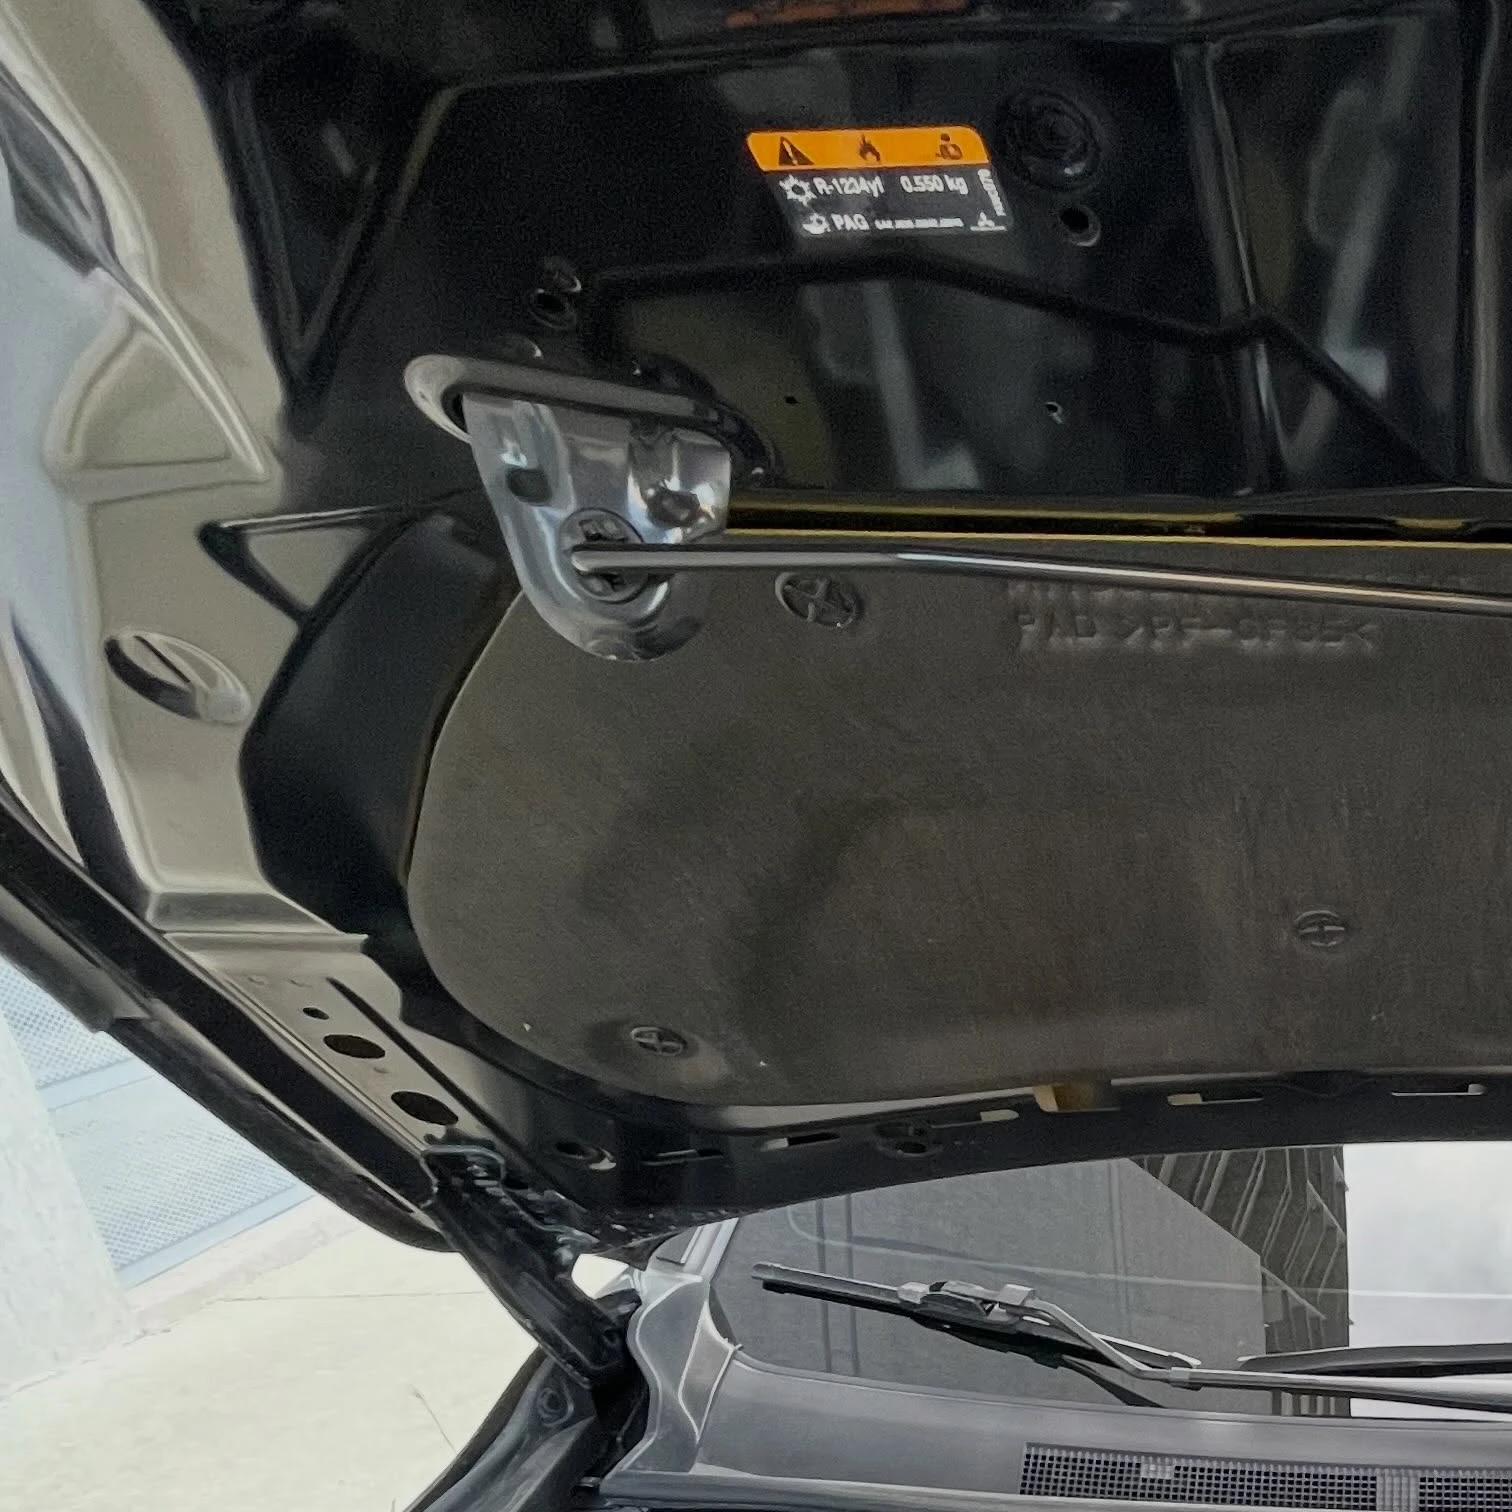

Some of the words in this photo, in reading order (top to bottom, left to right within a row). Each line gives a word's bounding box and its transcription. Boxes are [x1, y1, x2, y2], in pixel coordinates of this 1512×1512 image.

[900, 175, 944, 193] 0.550
[944, 174, 969, 195] kg
[831, 213, 869, 230] PAG
